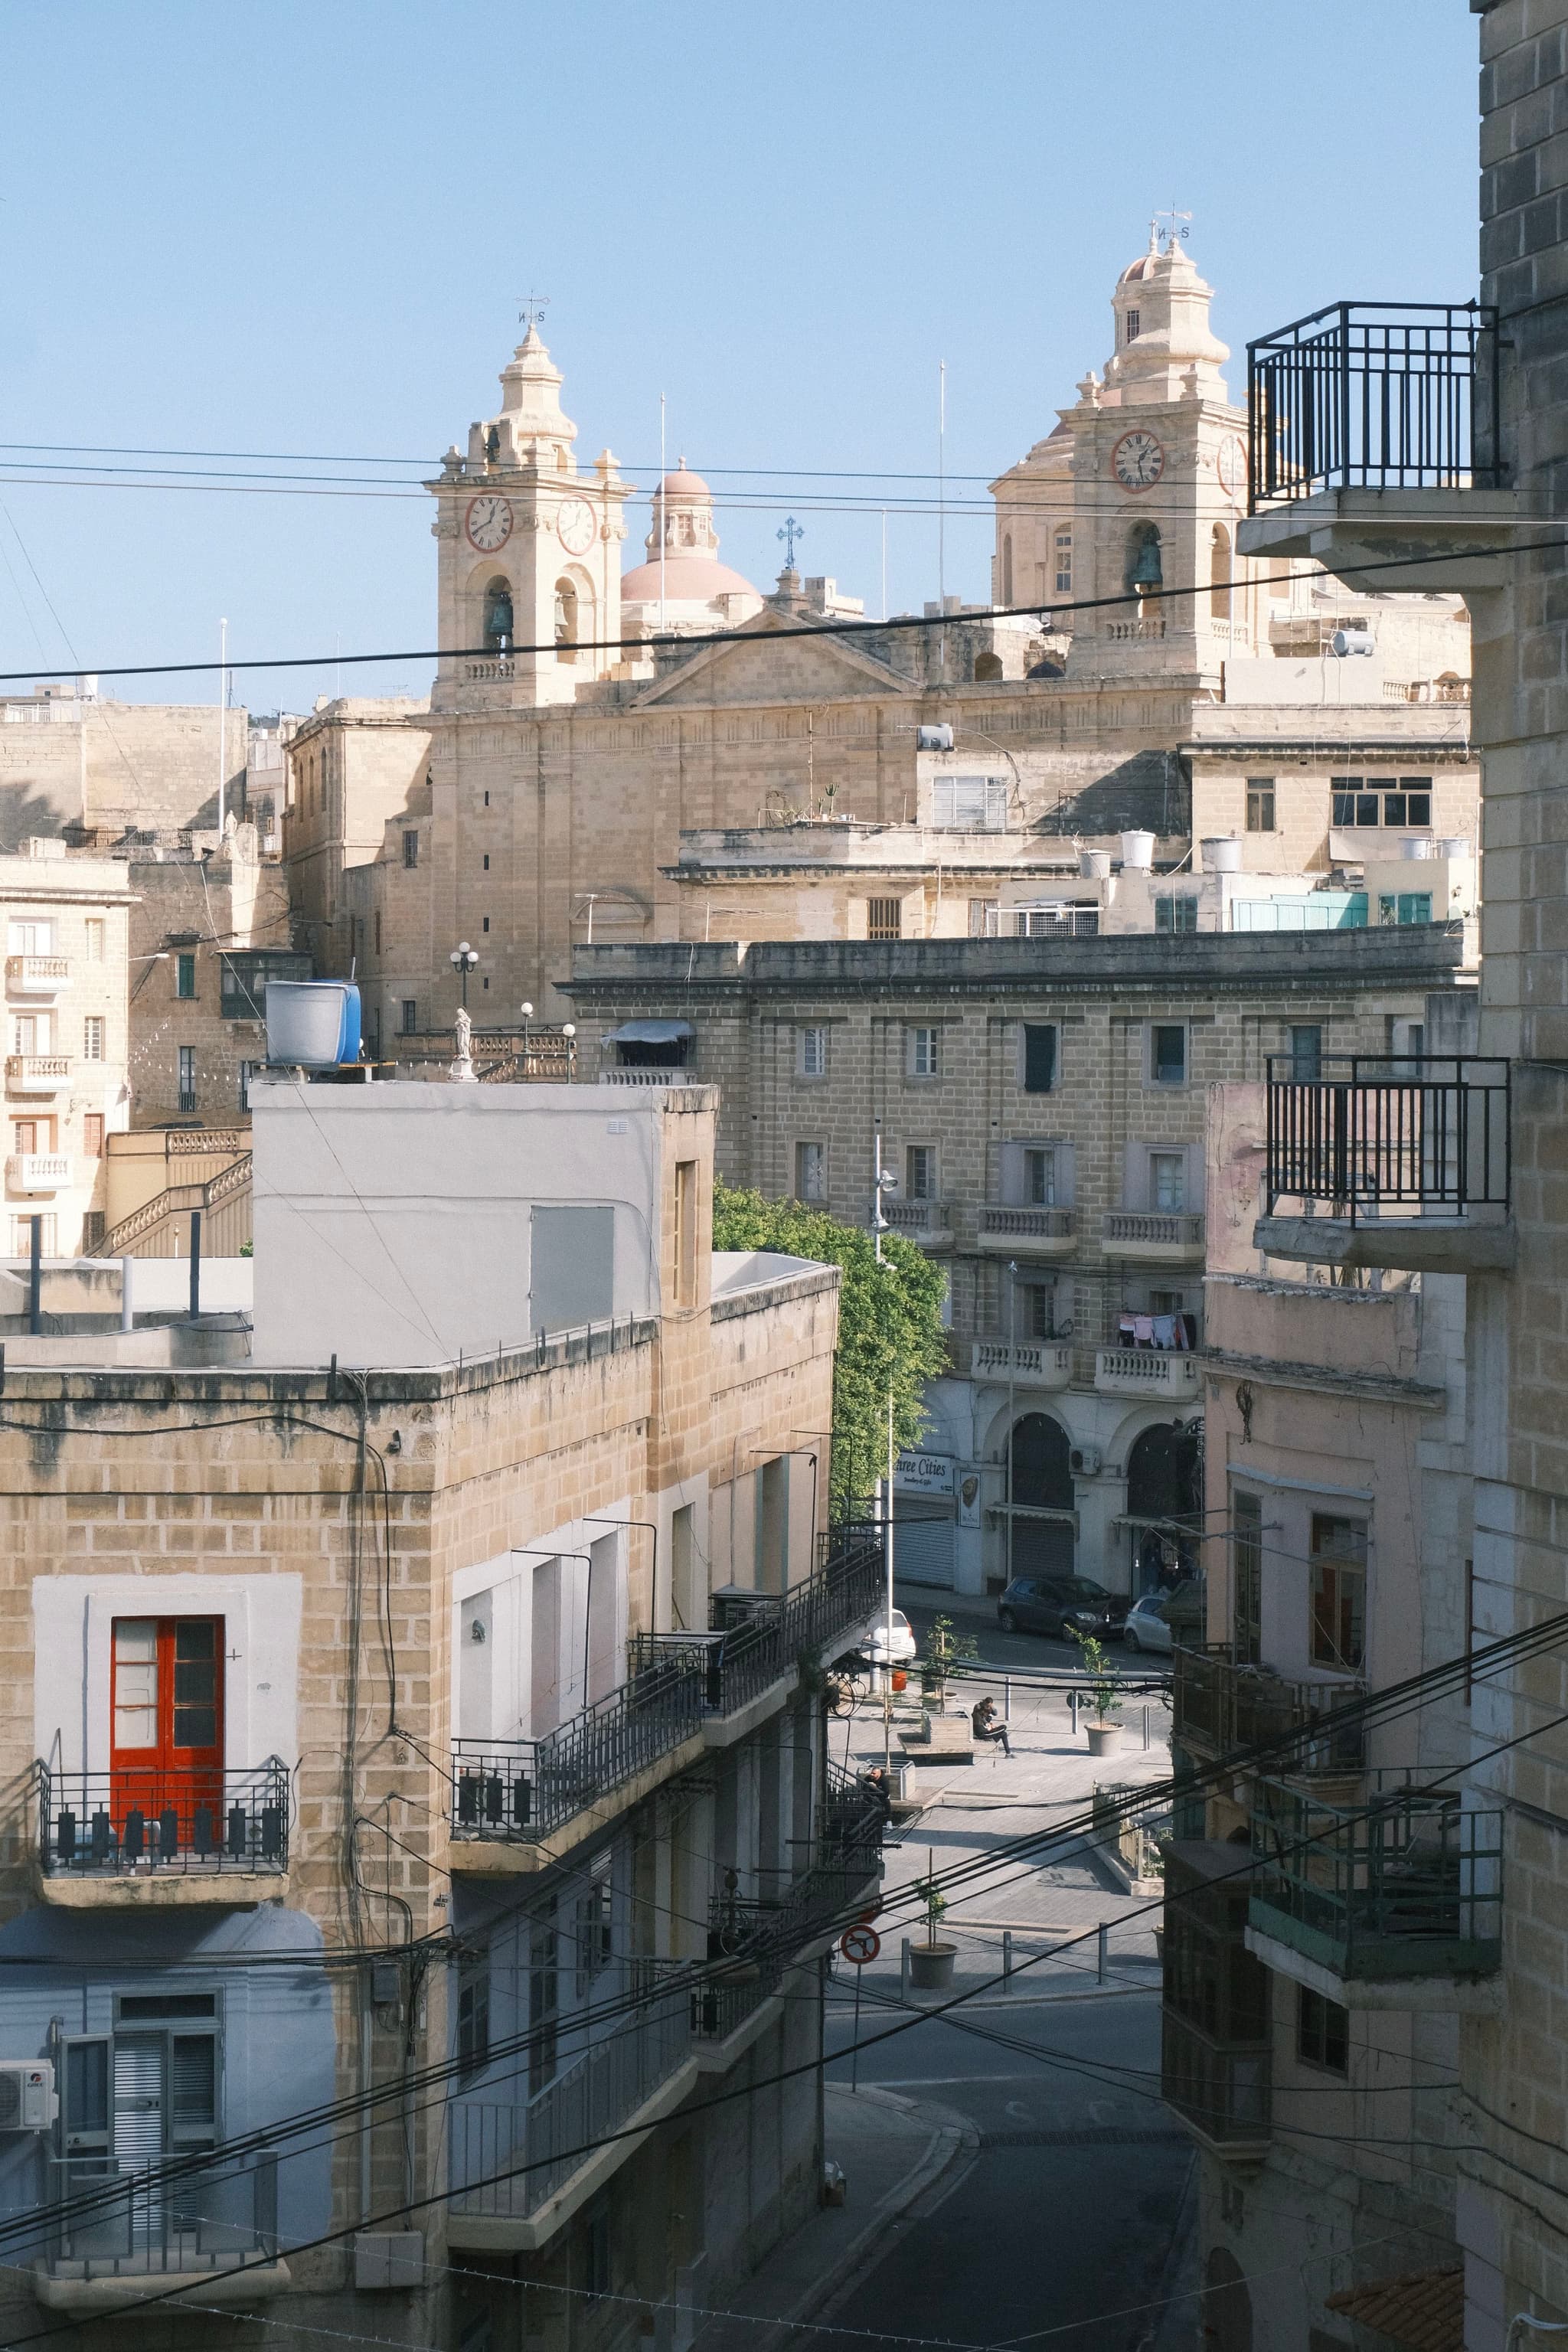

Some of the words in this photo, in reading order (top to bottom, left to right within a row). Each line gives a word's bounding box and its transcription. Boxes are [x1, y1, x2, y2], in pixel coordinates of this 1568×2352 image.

[1181, 227, 1190, 238] S
[537, 312, 545, 322] S
[894, 1459, 916, 1473] hree
[919, 1458, 946, 1476] Cities
